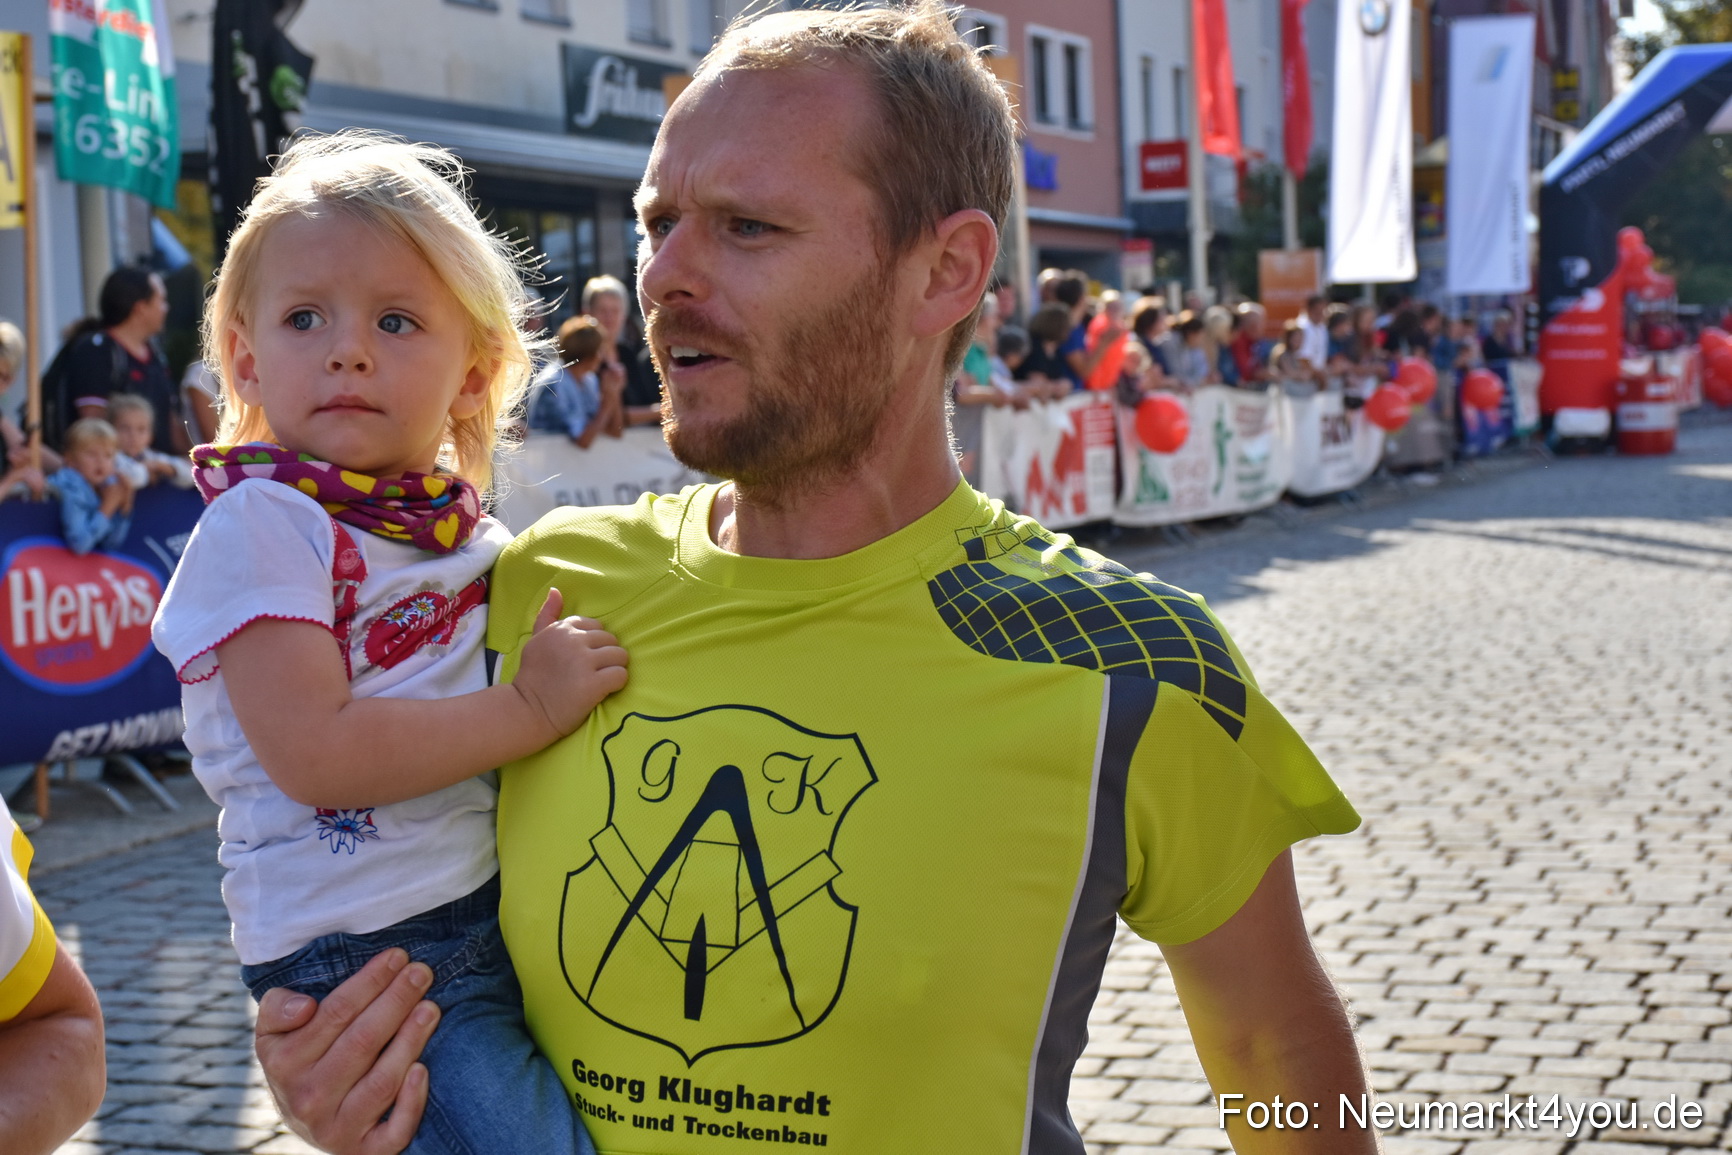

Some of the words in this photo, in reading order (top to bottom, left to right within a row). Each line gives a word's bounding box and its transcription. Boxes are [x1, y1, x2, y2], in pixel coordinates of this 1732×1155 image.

[74, 114, 171, 177] 6352
[8, 566, 155, 650] Hervis
[762, 751, 842, 816] K
[571, 1058, 645, 1104] Georg
[658, 1075, 831, 1117] Klughardt
[574, 1092, 625, 1124] Stuck-
[632, 1114, 674, 1133] und
[683, 1115, 828, 1147] Trockenbau
